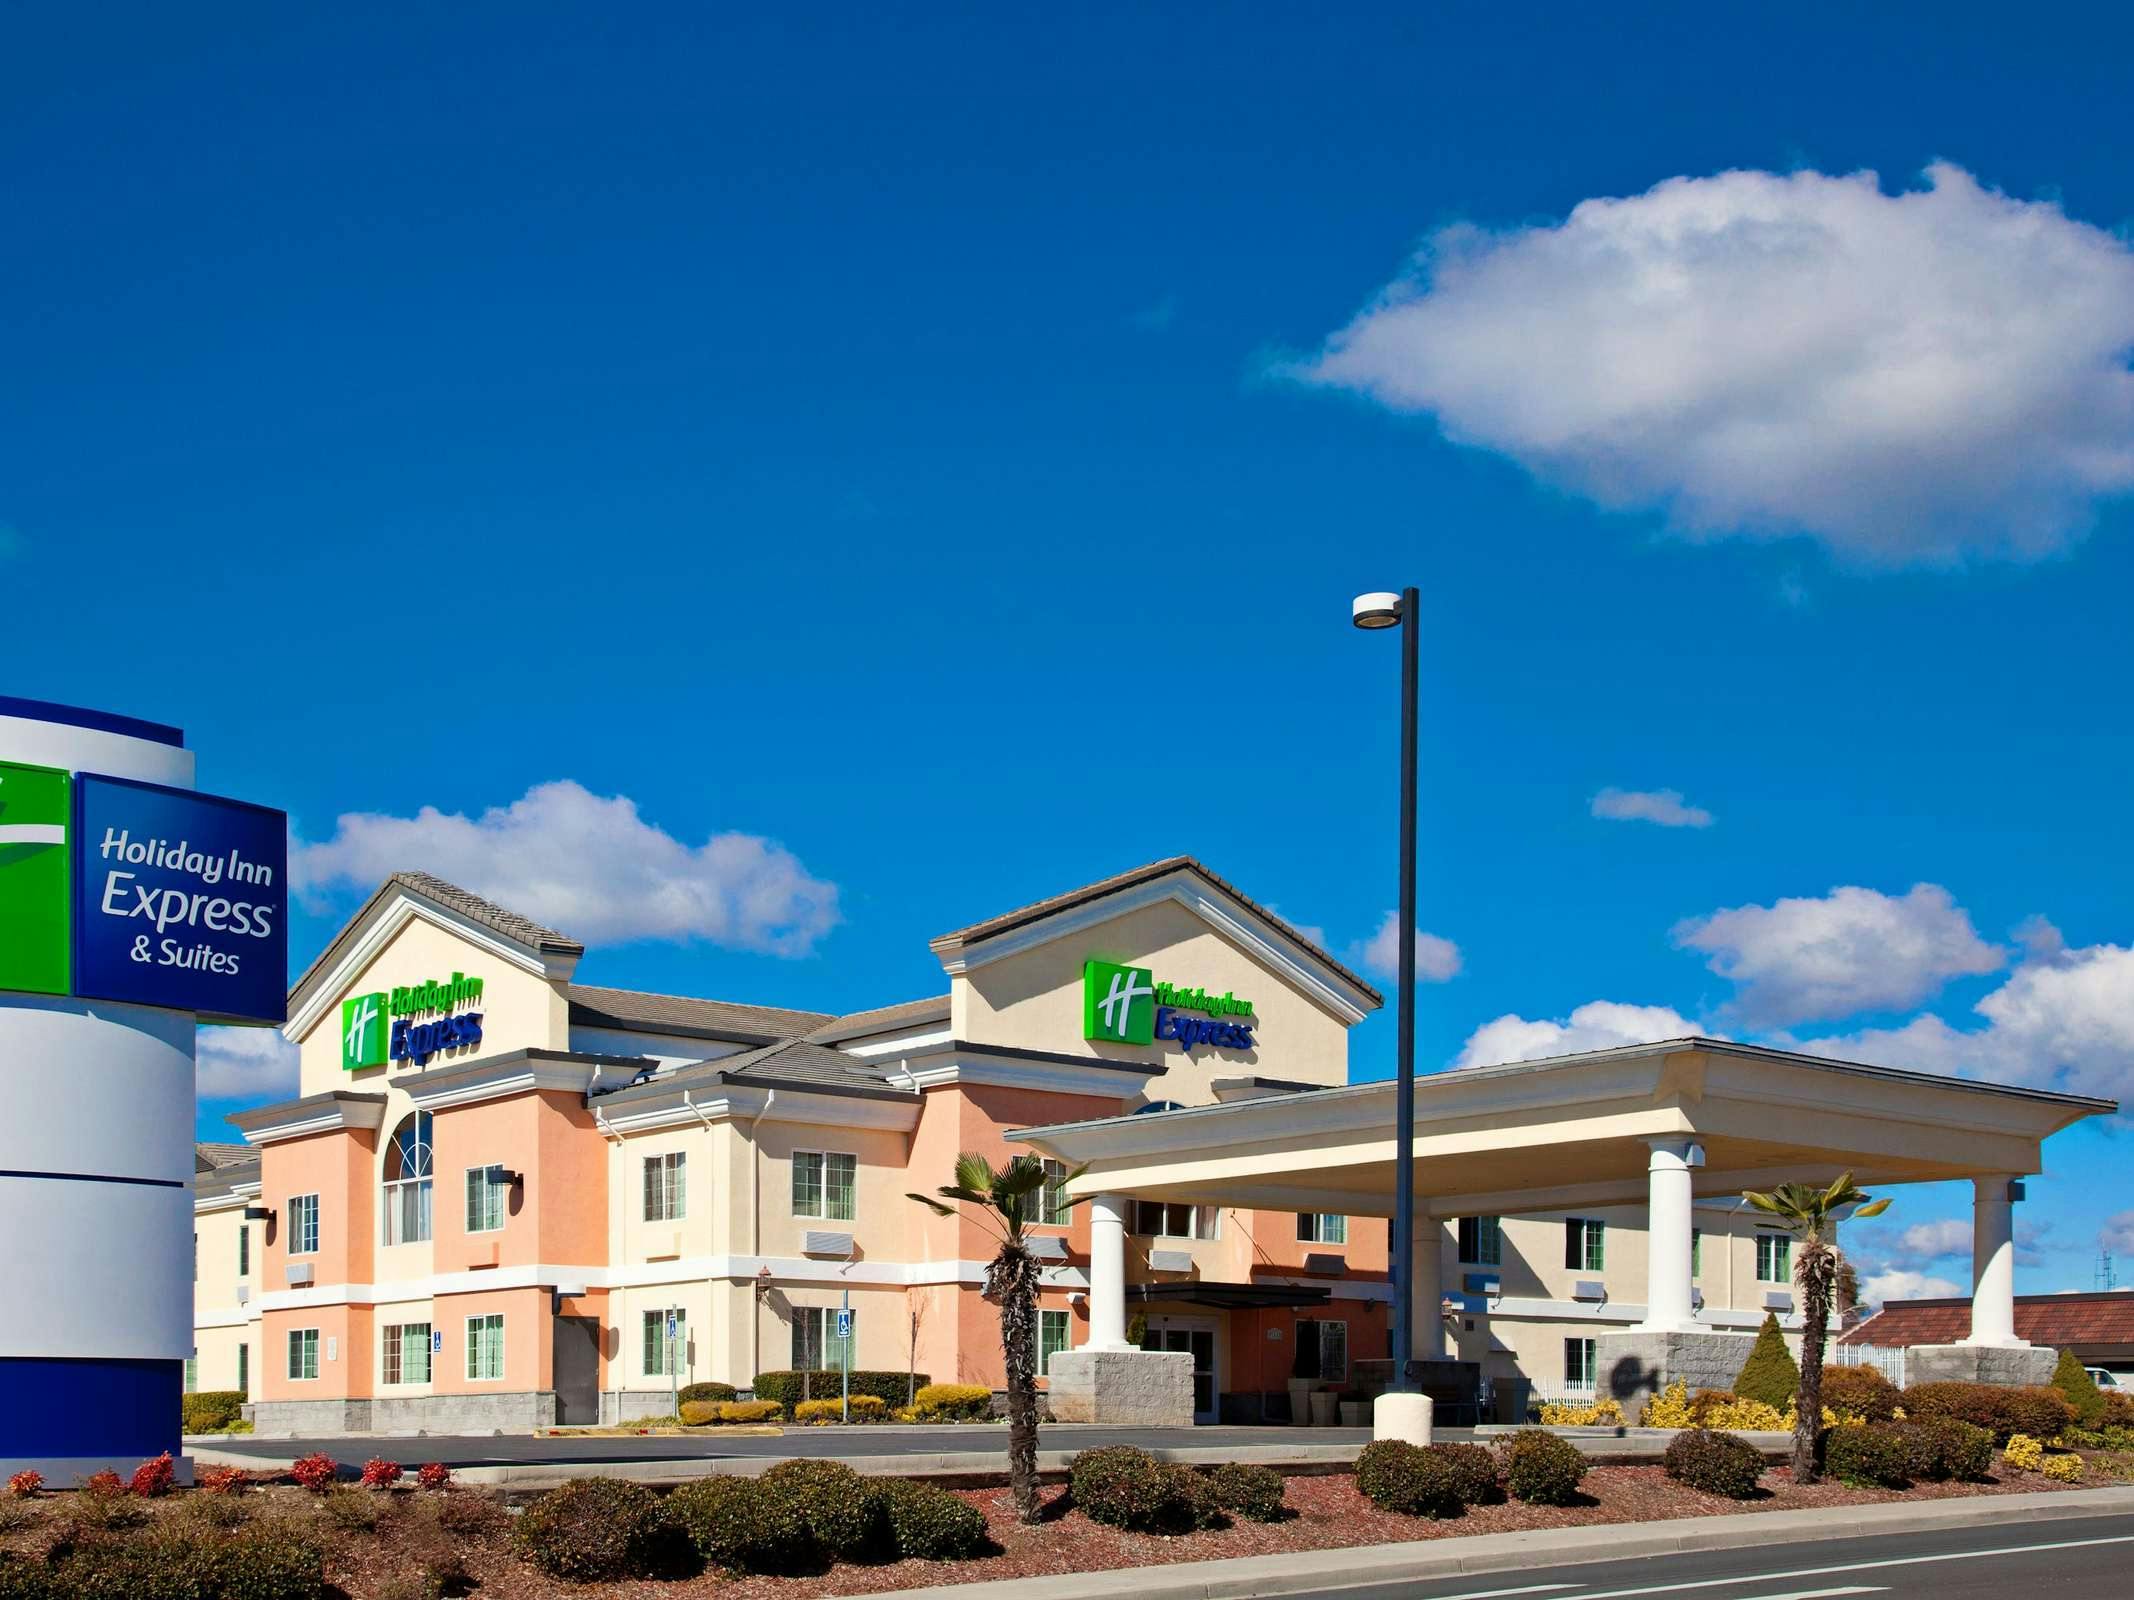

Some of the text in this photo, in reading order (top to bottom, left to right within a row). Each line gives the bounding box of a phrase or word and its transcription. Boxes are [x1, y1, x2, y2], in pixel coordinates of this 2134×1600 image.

[100, 828, 273, 887] Holiday Inn
[101, 870, 273, 938] Express
[130, 935, 240, 975] & Suites
[389, 971, 484, 1016] Holiday Inn
[1154, 982, 1254, 1018] Holiday Inn
[390, 1011, 484, 1067] Express
[1154, 1007, 1254, 1051] Express
